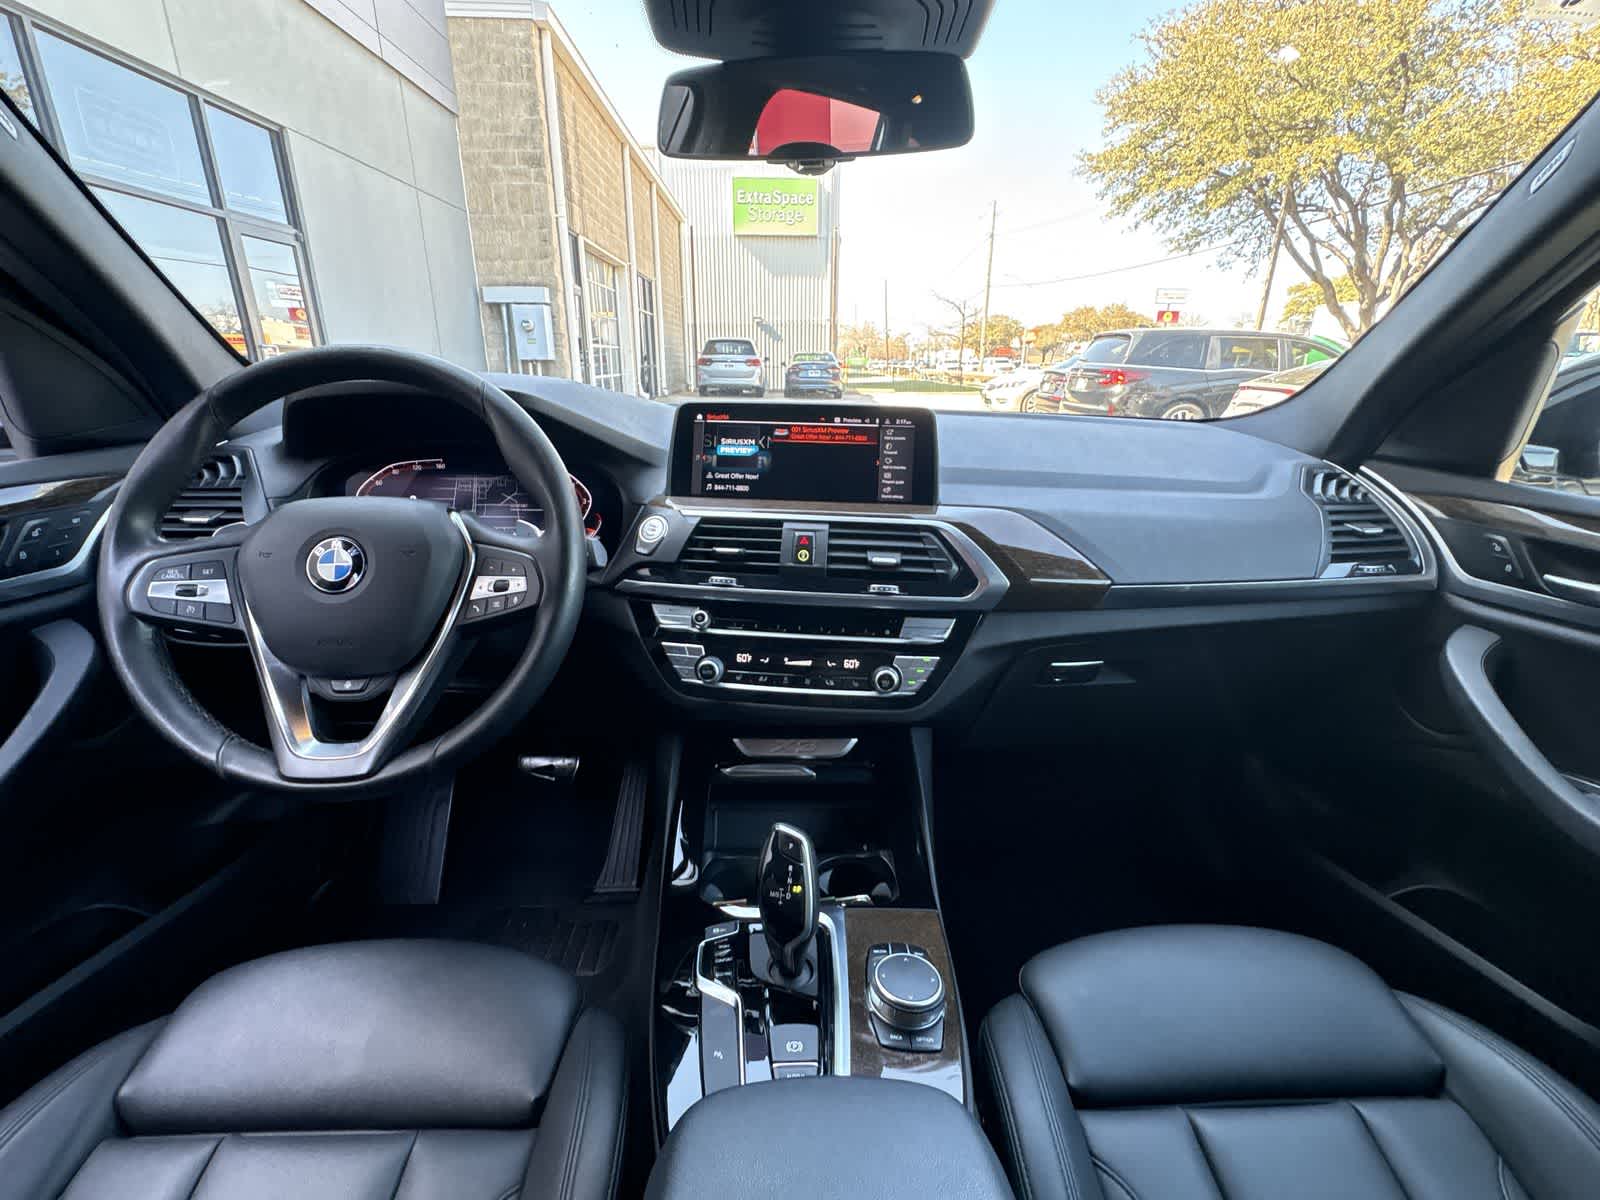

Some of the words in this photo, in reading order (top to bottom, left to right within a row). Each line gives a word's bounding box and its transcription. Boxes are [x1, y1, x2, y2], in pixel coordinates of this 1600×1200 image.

[748, 207, 804, 225] Storage
[720, 437, 756, 445] SIRIUSXM
[730, 472, 744, 480] Offer
